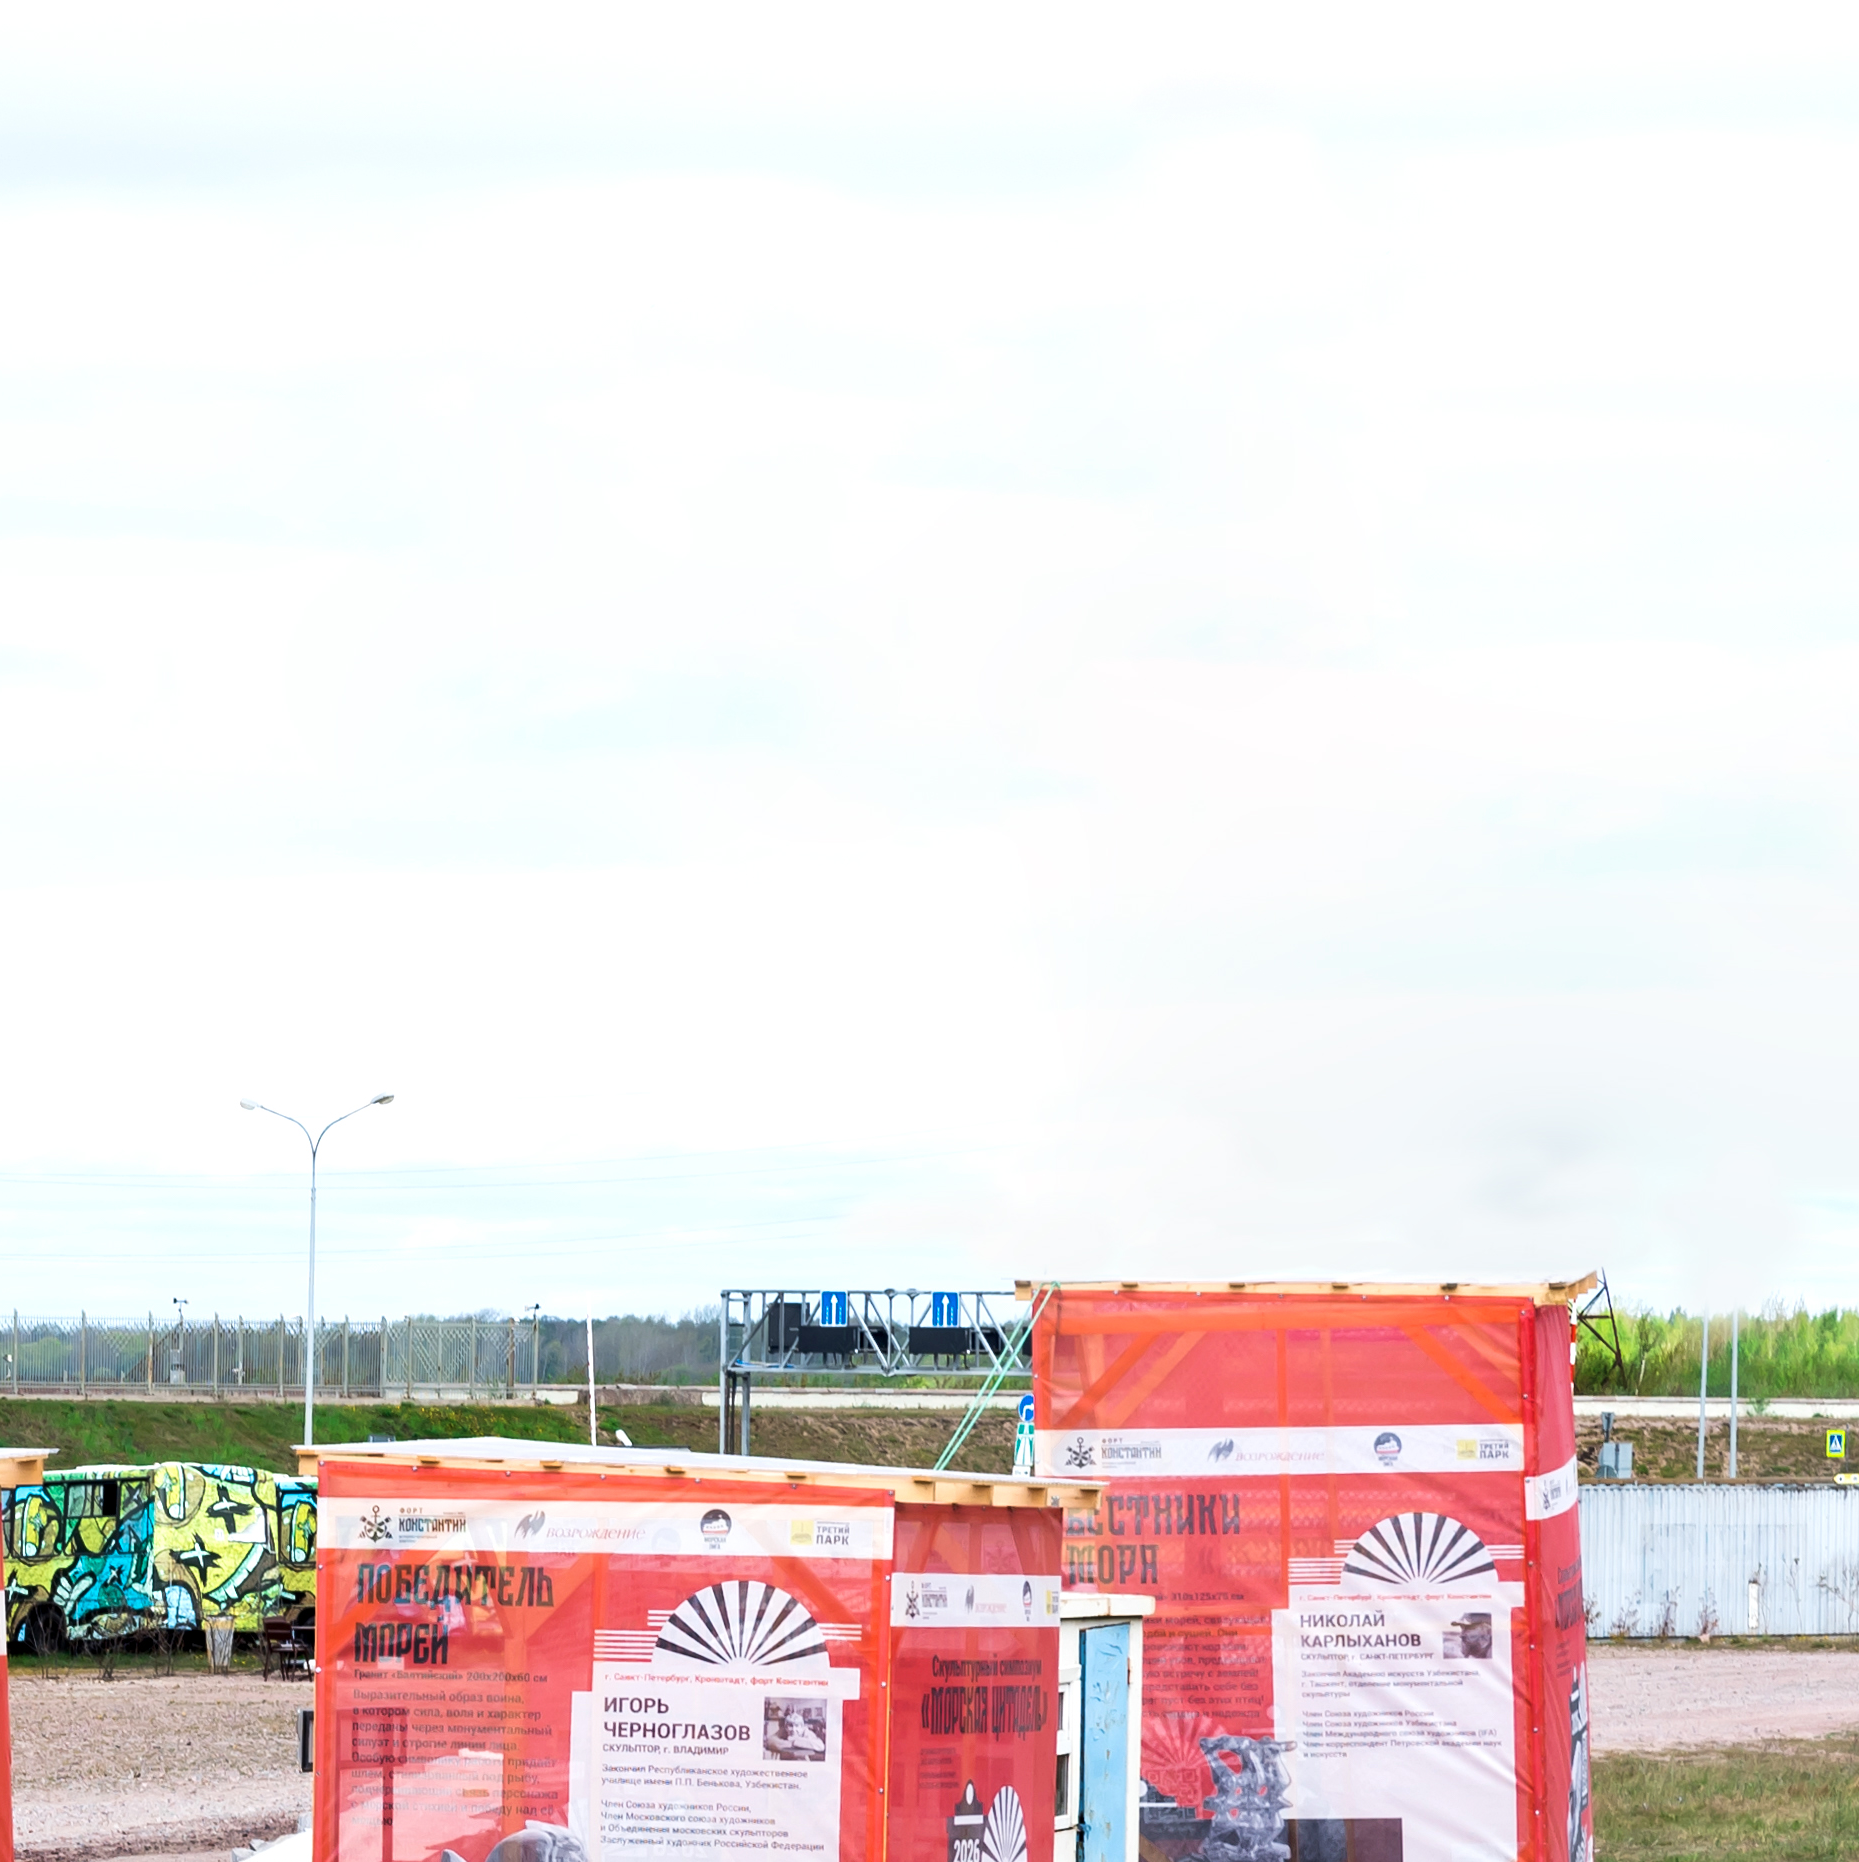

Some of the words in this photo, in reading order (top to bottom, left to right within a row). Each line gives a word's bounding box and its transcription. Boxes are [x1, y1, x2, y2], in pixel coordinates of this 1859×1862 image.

[1101, 1447, 1162, 1459] КОНСТАНТИН
[1479, 1451, 1509, 1459] ПАРК
[399, 1517, 466, 1533] КОНСТАНТИН
[816, 1535, 849, 1545] ПАРК
[1067, 1543, 1159, 1585] МОРЯ
[357, 1563, 554, 1612] ПОБЕДИТЕЛЬ
[1300, 1610, 1385, 1628] НИКОЛАЙ
[1301, 1634, 1421, 1648] КАРЛЫХАНОВ
[1360, 1652, 1434, 1661] САНКТ-ПЕТЕРБУРГ
[933, 1654, 998, 1682] Скульптурный
[1000, 1659, 1041, 1682] симпозиум
[353, 1689, 446, 1702] Выразительный
[604, 1697, 669, 1714] ИГОРЬ
[922, 1686, 987, 1734] «МОРСКАЯ
[992, 1686, 1048, 1741] ЦИТАДЕЛЬ»
[448, 1724, 551, 1736] монументальный
[604, 1722, 750, 1741] ЧЕРНОГЛАЗОВ
[603, 1744, 661, 1755] СКУЛЬПТОР,
[673, 1746, 729, 1755] ВЛАДИМИР
[648, 1765, 728, 1777] Республиканское
